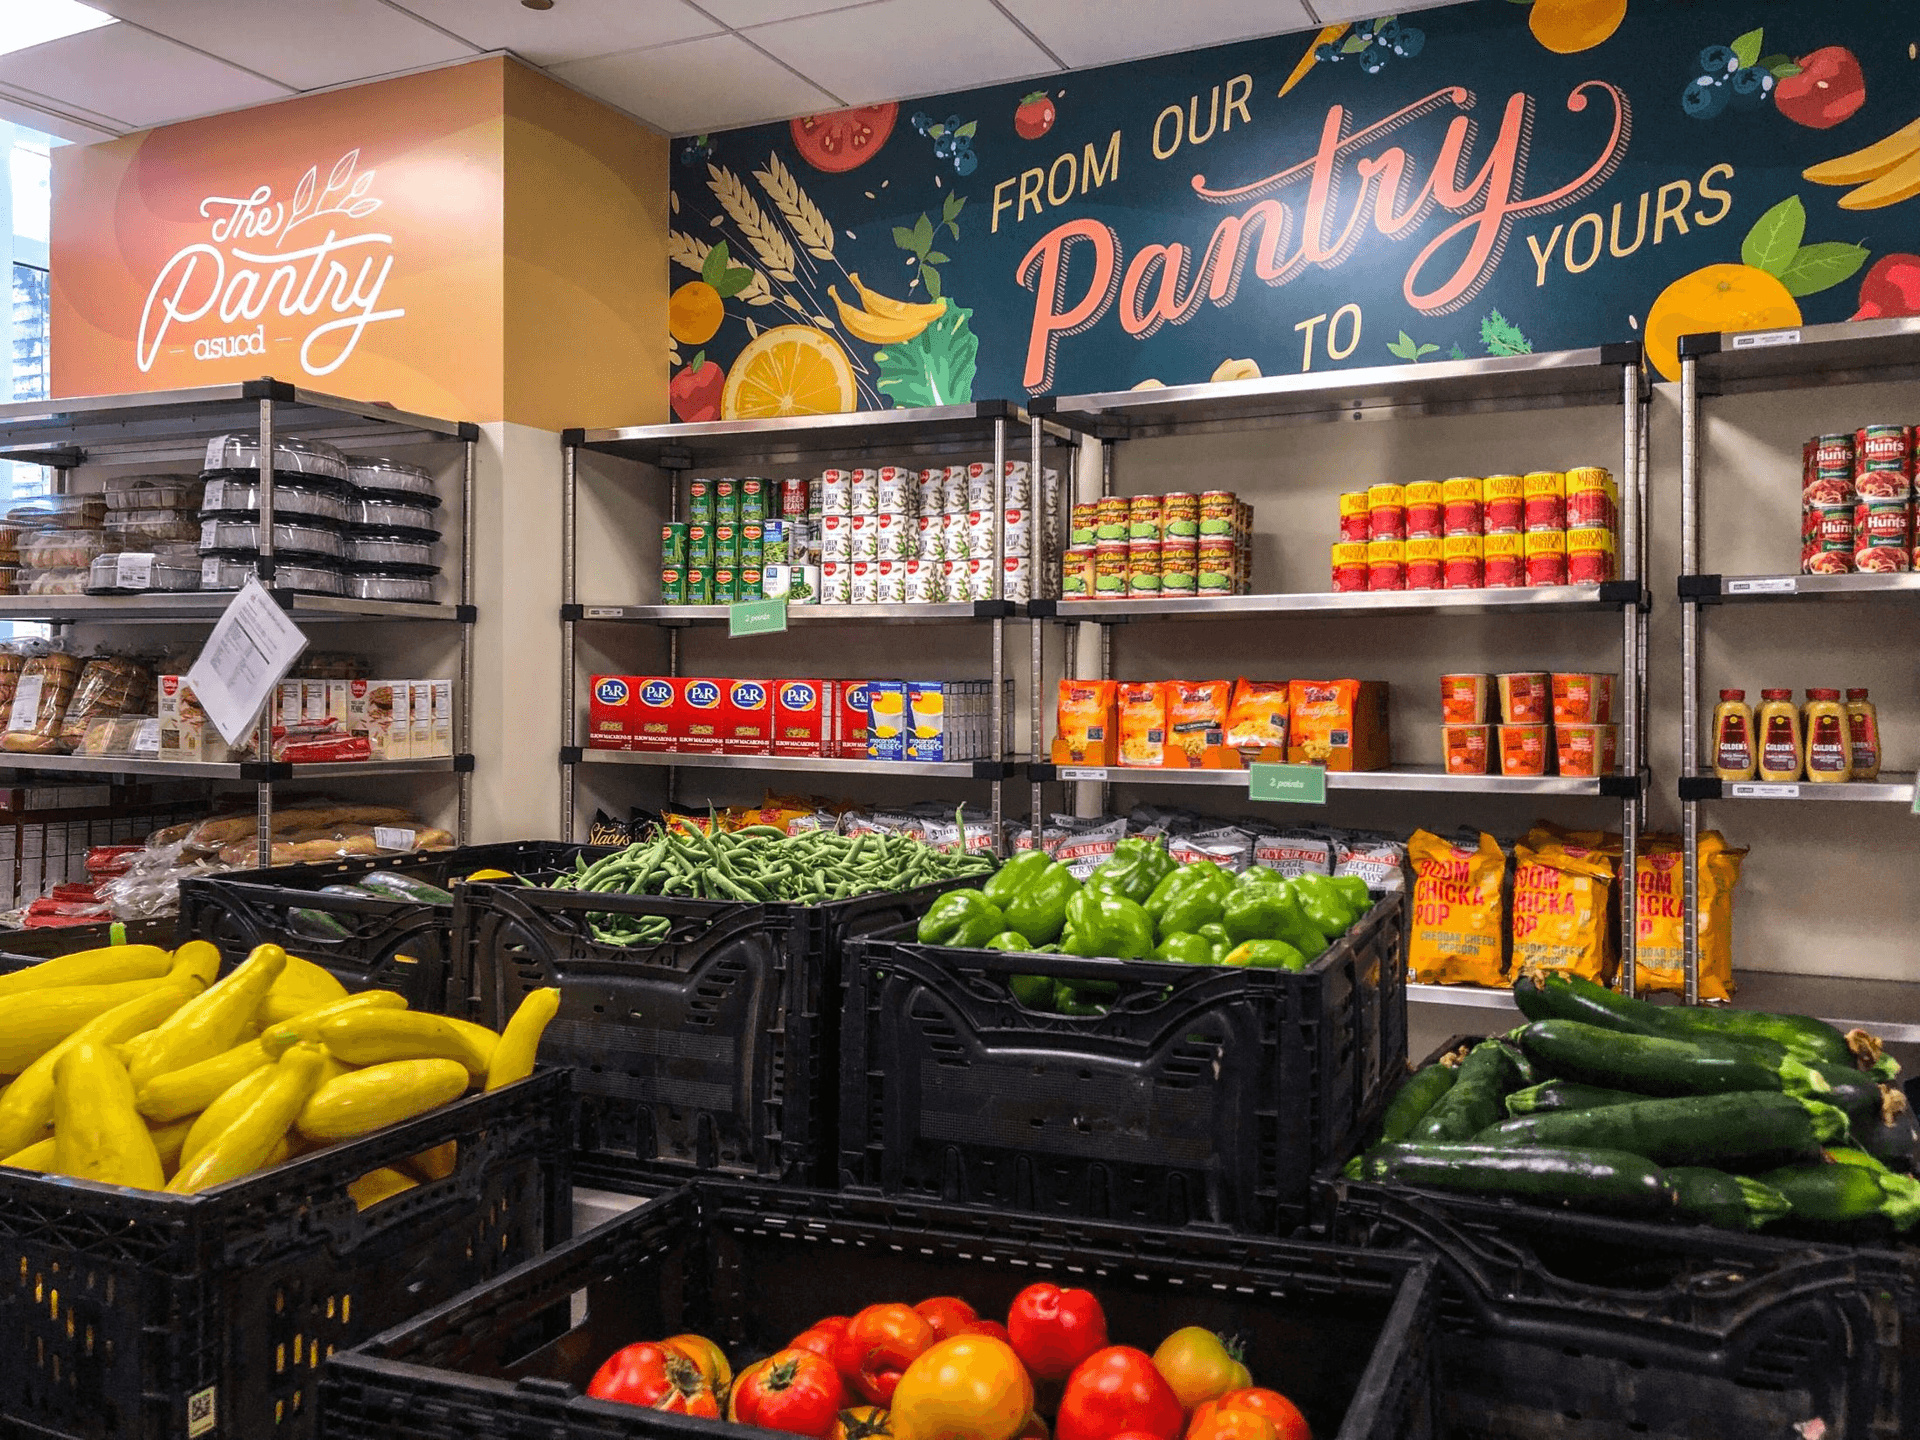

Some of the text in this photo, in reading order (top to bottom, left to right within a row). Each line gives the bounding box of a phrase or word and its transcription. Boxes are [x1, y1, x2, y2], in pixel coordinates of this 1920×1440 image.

[989, 74, 1252, 234] FROM OUR
[199, 185, 284, 242] The
[1526, 162, 1735, 288] YOURS
[1016, 80, 1632, 395] Pantry
[136, 230, 405, 376] Pantry
[193, 325, 266, 361] asucd
[1294, 303, 1362, 371] TO
[602, 684, 624, 697] P&R
[646, 686, 669, 699] P&R
[691, 687, 715, 700] P&R
[736, 688, 761, 701] P&R
[786, 690, 811, 703] P&R
[853, 691, 868, 703] P&
[1269, 777, 1305, 789] 2 points
[590, 822, 632, 847] Stacy's
[1015, 838, 1033, 848] SPIC
[1076, 855, 1102, 865] EGGIE
[1256, 848, 1325, 864] SPICY SRIRACHA
[1270, 859, 1304, 869] VEGGIE
[1636, 870, 1672, 894] OM
[1418, 881, 1485, 906] CHICKA
[1514, 890, 1576, 916] HICKA
[1416, 903, 1450, 926] POP
[1514, 915, 1538, 937] OP
